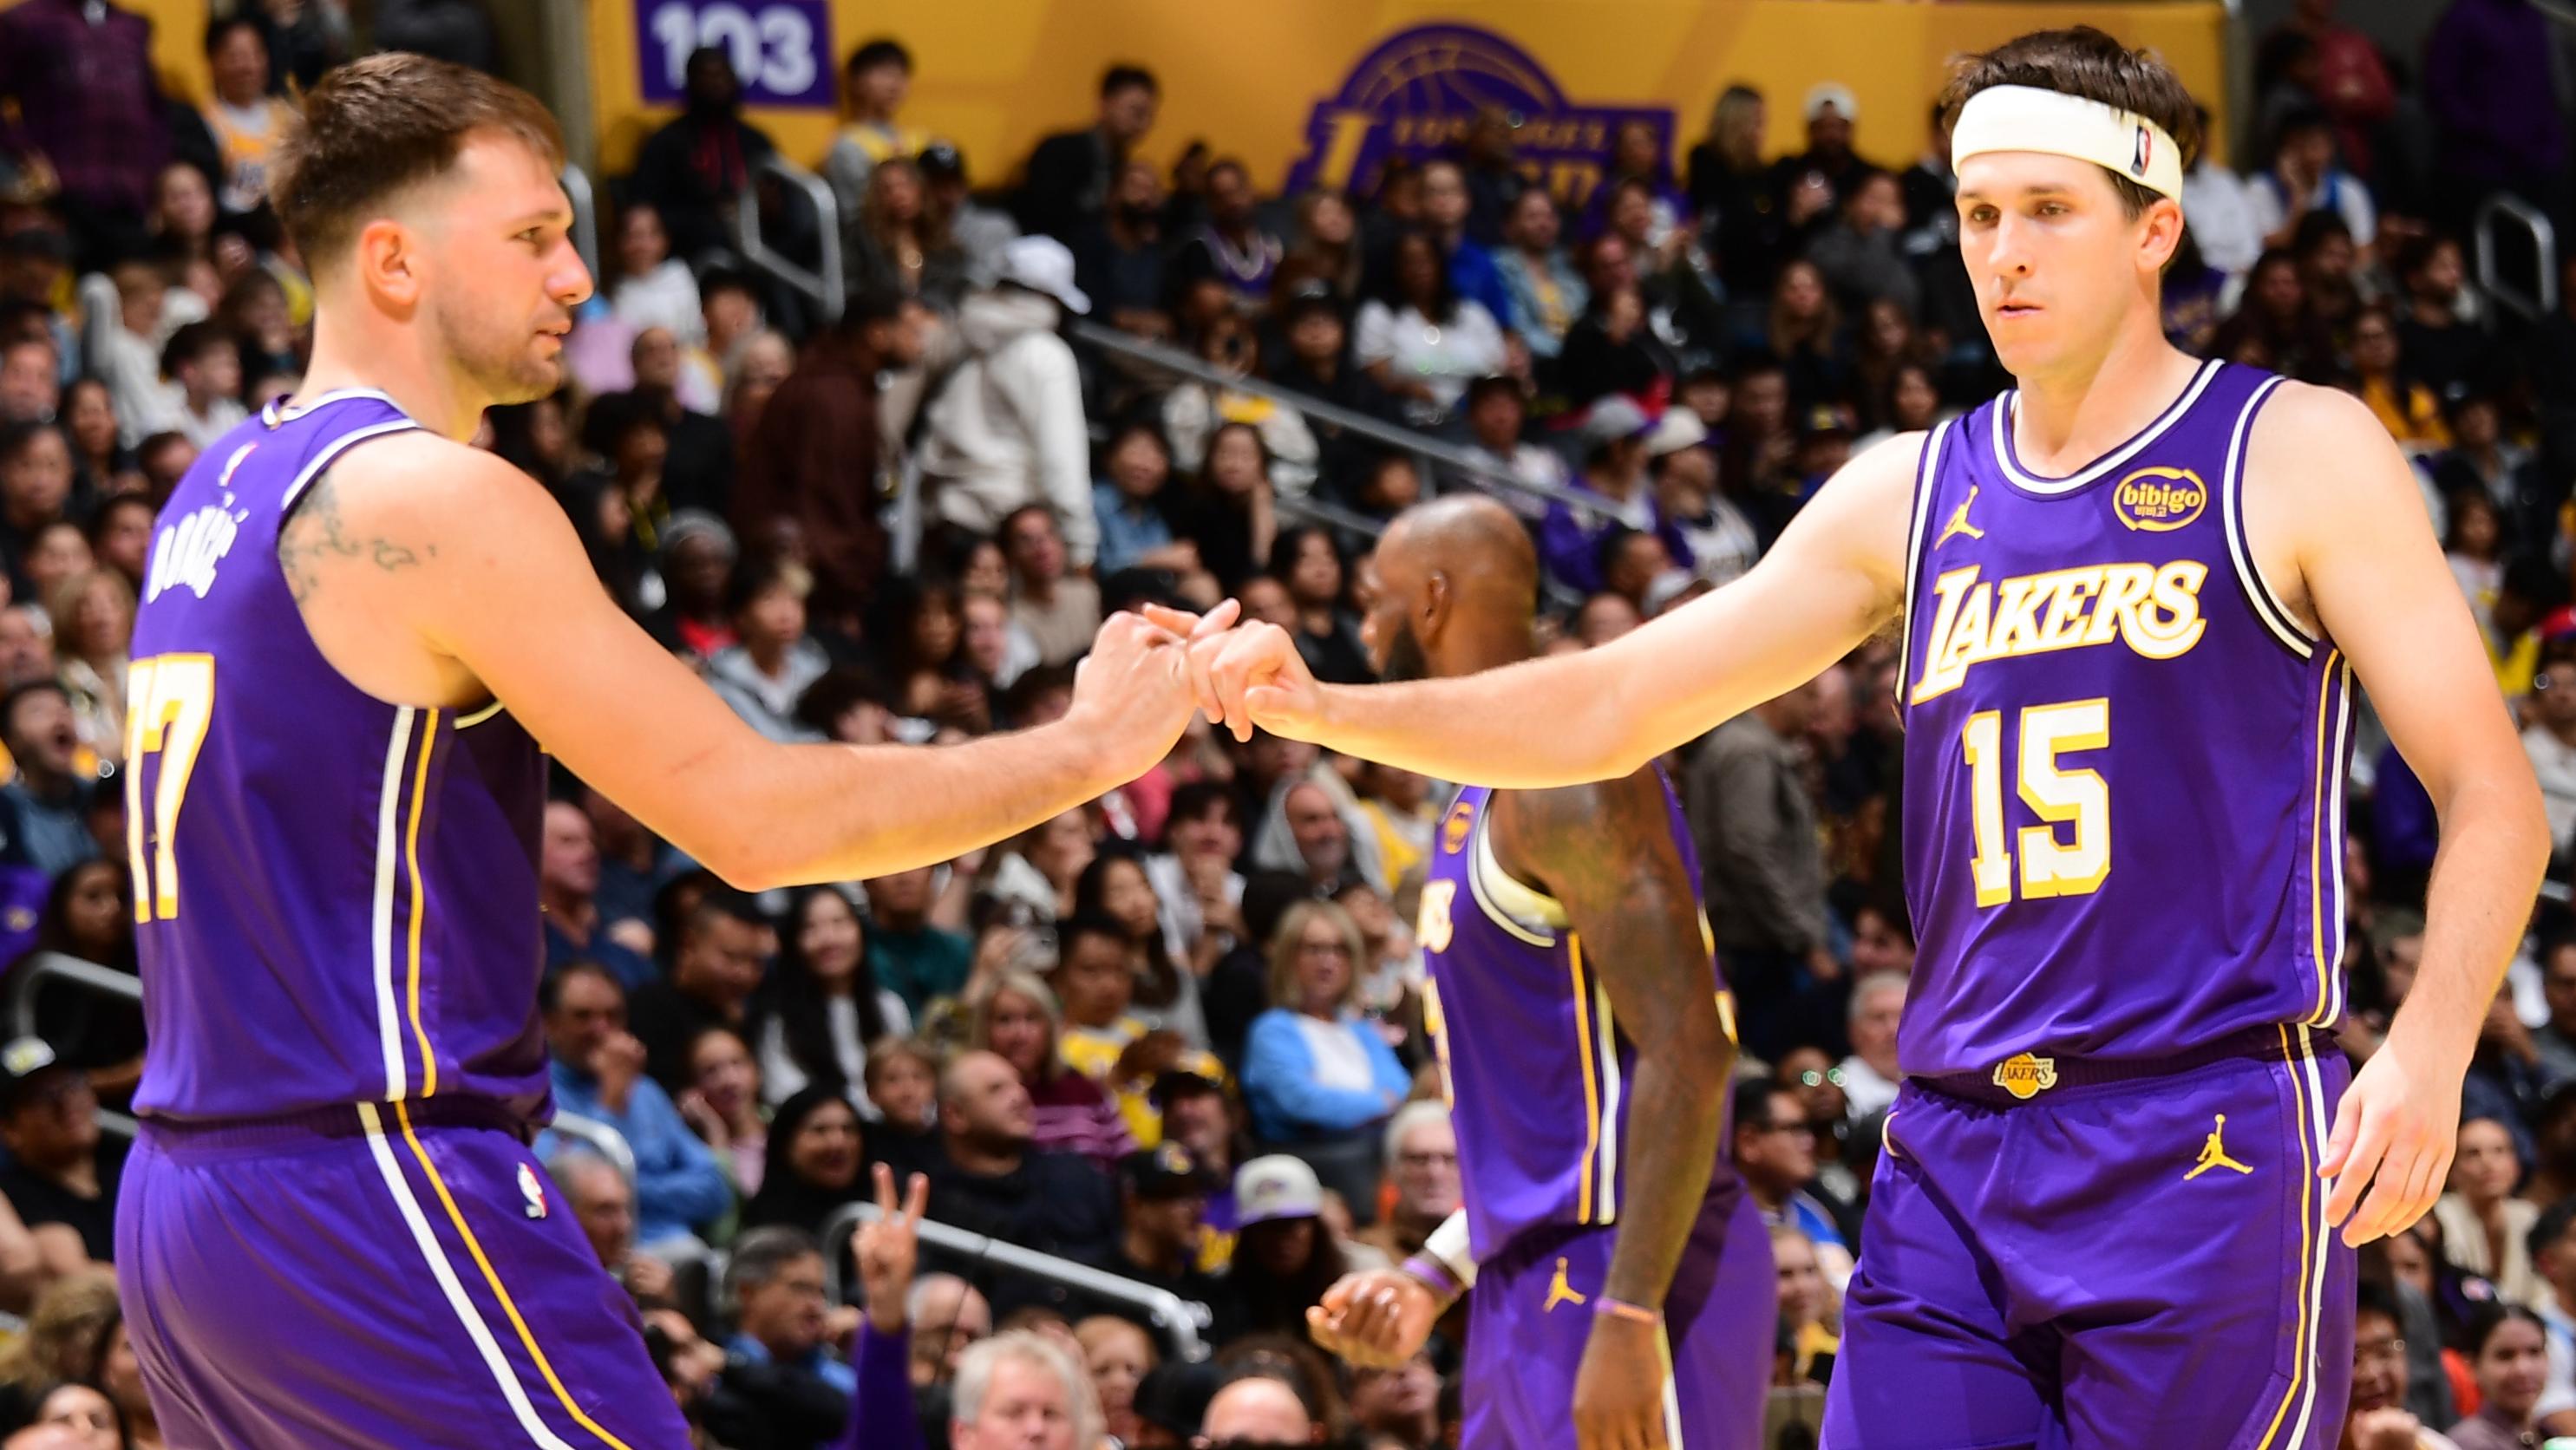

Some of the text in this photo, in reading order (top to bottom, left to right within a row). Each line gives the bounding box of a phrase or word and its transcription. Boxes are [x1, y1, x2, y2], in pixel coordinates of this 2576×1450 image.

[651, 2, 818, 95] 103
[2123, 482, 2200, 513] bibigo
[1911, 560, 2209, 706] LAKERS
[123, 652, 215, 924] 77
[1963, 697, 2111, 909] 15
[1997, 1062, 2052, 1085] LAKERS
